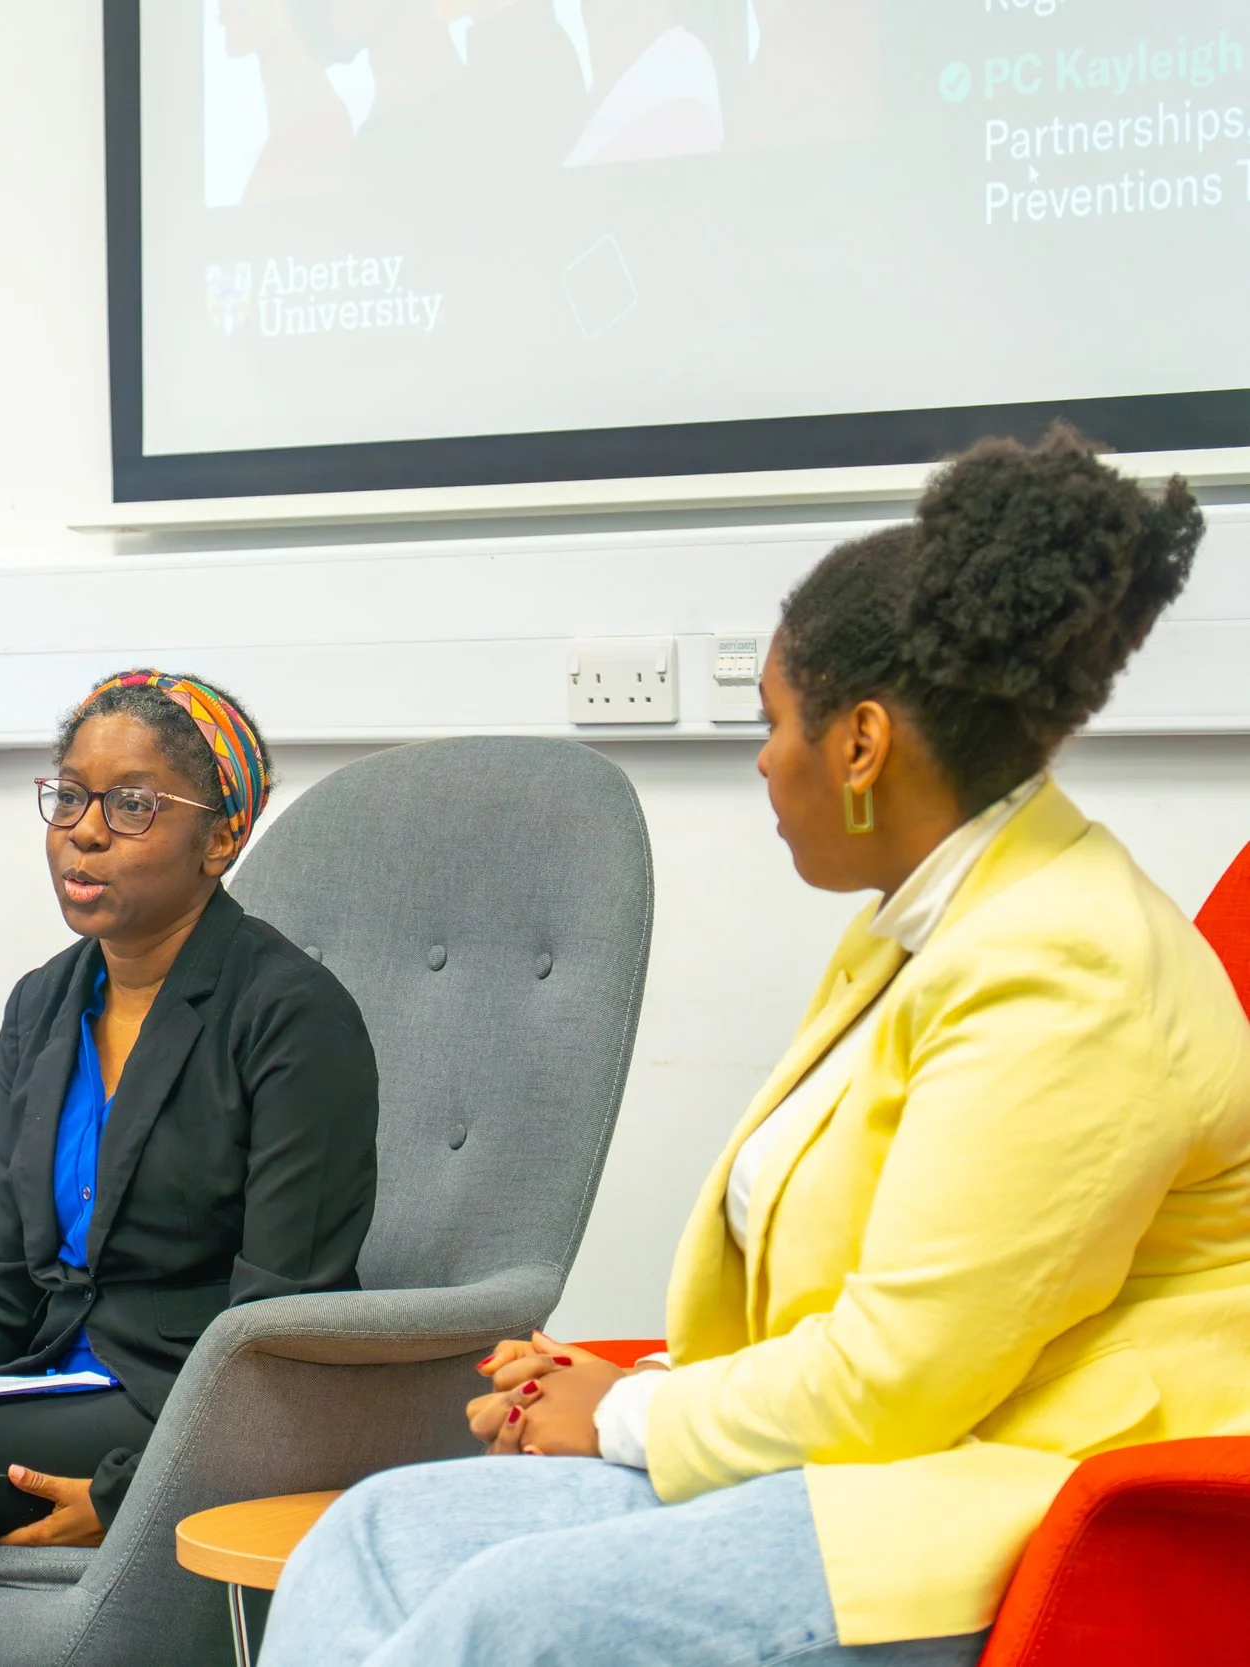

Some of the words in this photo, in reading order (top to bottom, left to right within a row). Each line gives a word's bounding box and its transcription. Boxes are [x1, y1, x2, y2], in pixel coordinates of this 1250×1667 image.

[983, 52, 1043, 99] PC
[1055, 29, 1244, 98] Kayleigh
[985, 168, 1223, 225] Preventions
[258, 253, 404, 296] Abertay
[258, 289, 443, 337] University
